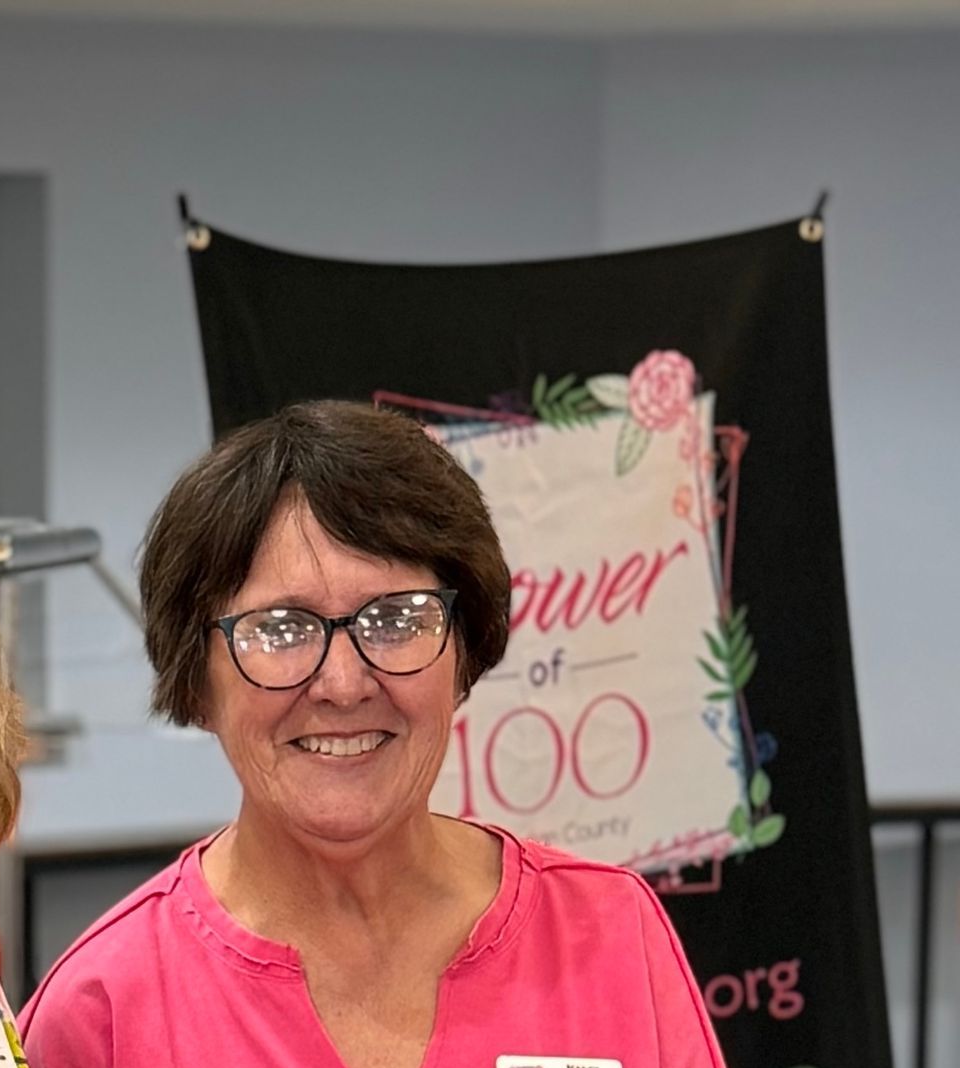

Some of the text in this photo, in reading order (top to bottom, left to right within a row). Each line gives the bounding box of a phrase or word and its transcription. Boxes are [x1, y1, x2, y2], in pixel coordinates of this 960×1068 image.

[508, 540, 689, 634] ower
[529, 651, 566, 687] of
[451, 694, 651, 819] 100
[563, 815, 632, 844] County
